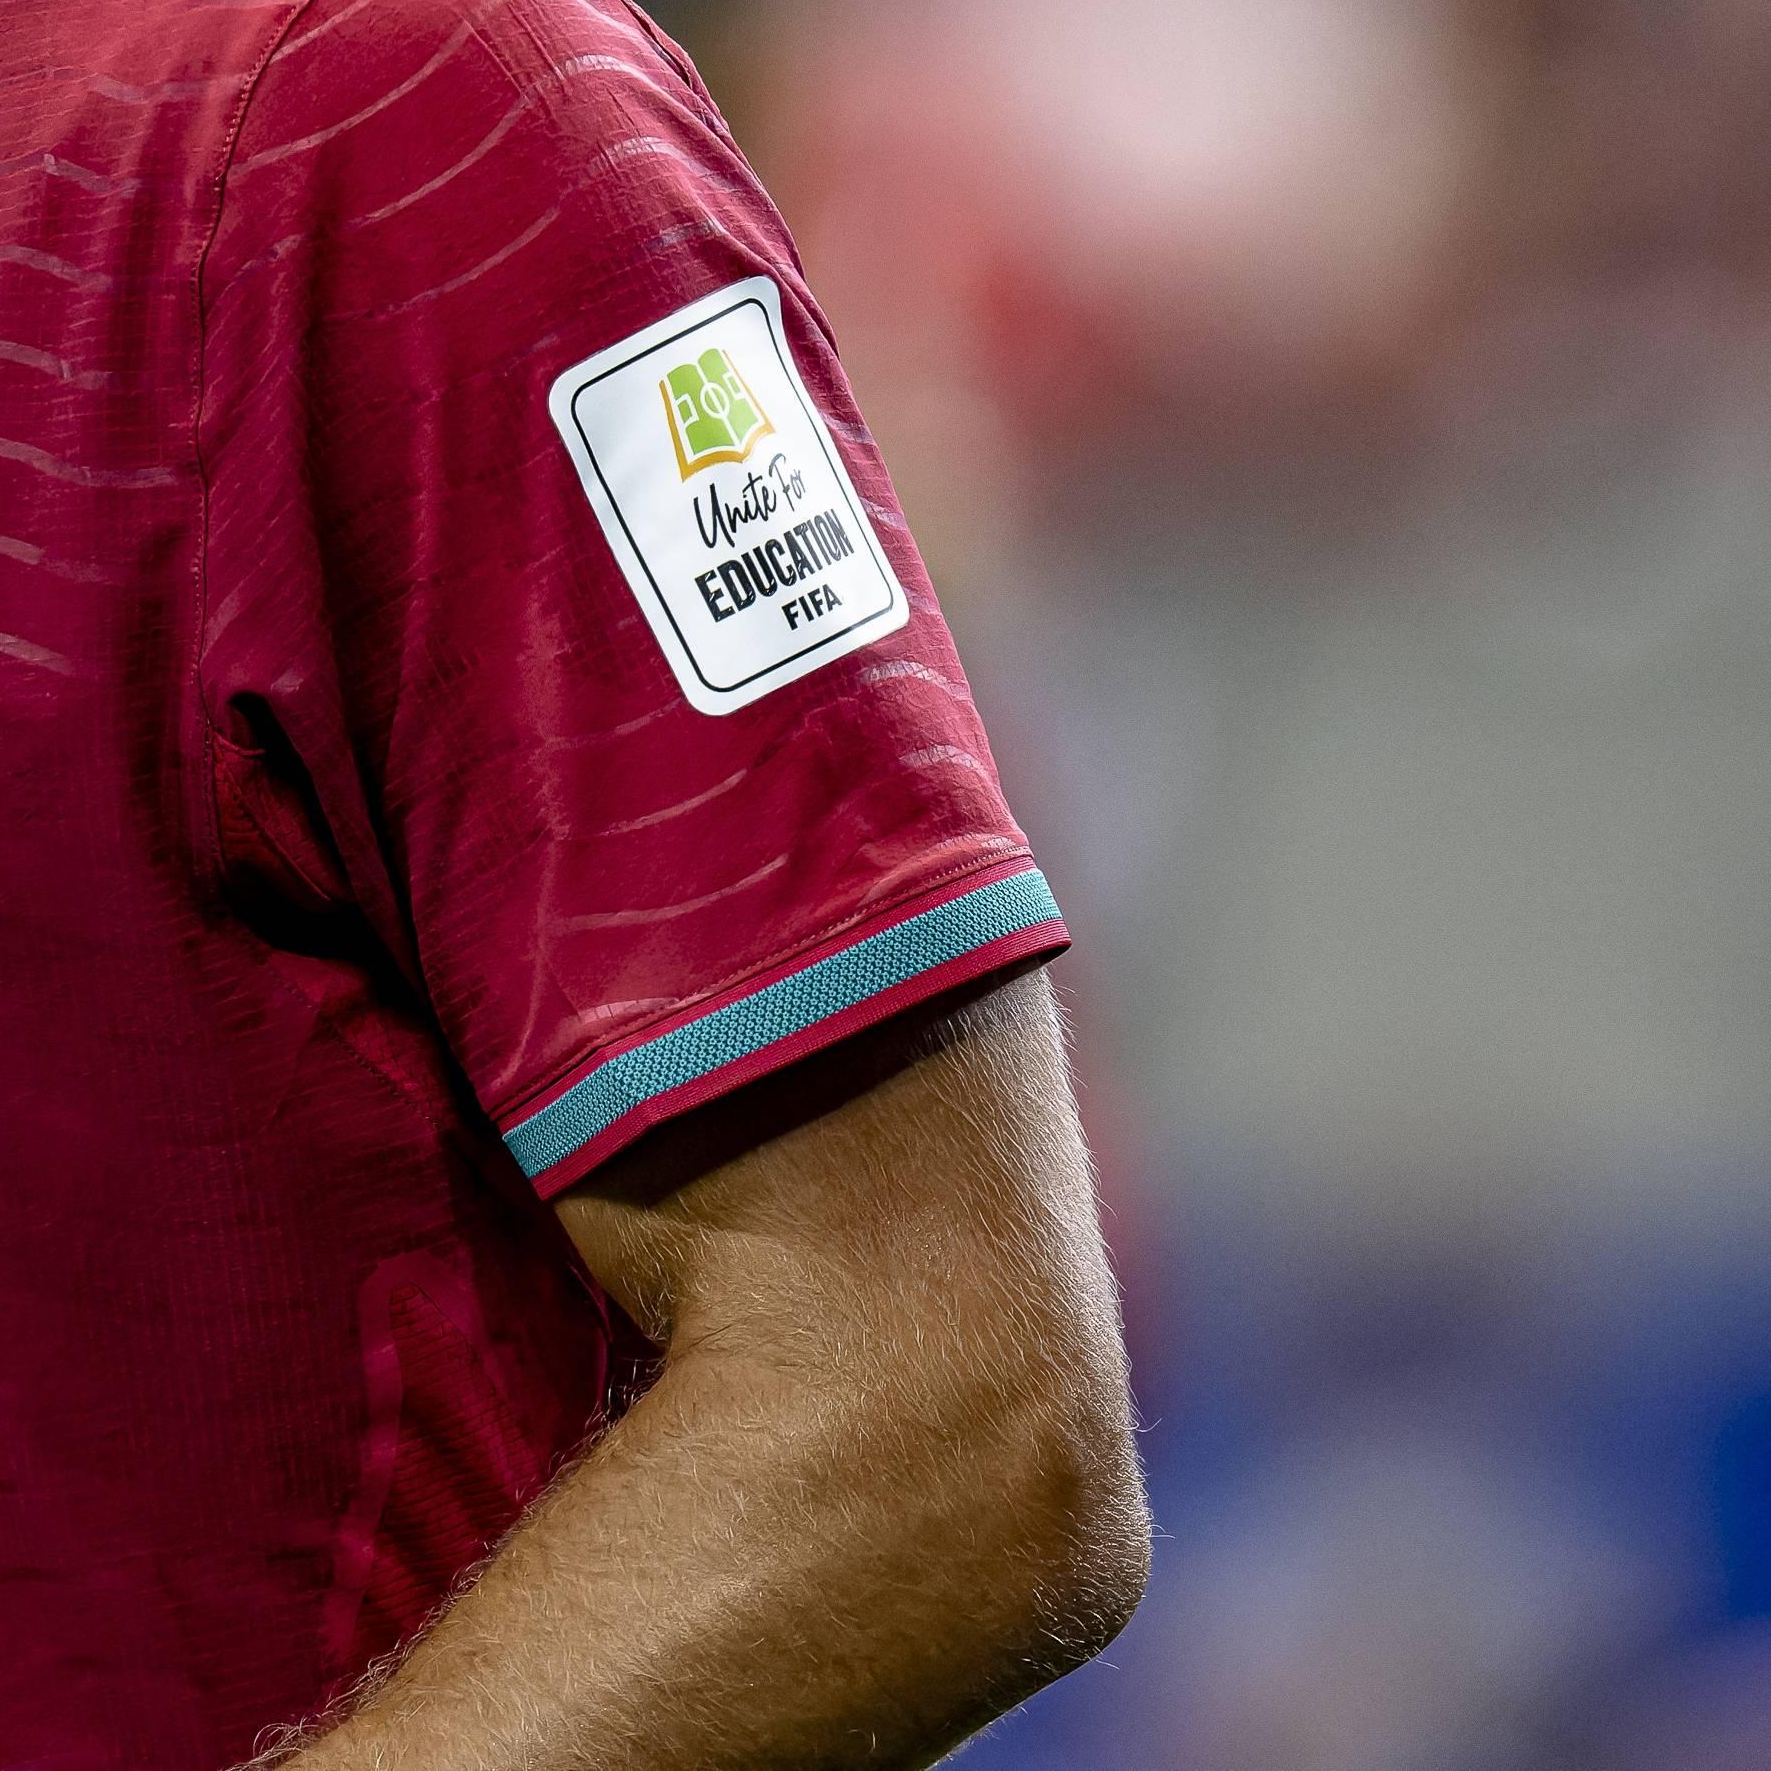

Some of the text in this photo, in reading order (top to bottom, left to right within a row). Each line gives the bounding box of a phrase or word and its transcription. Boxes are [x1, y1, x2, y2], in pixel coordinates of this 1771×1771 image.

[693, 452, 806, 549] Unite For
[693, 508, 855, 623] EDUCATION
[780, 583, 843, 631] FIFA
